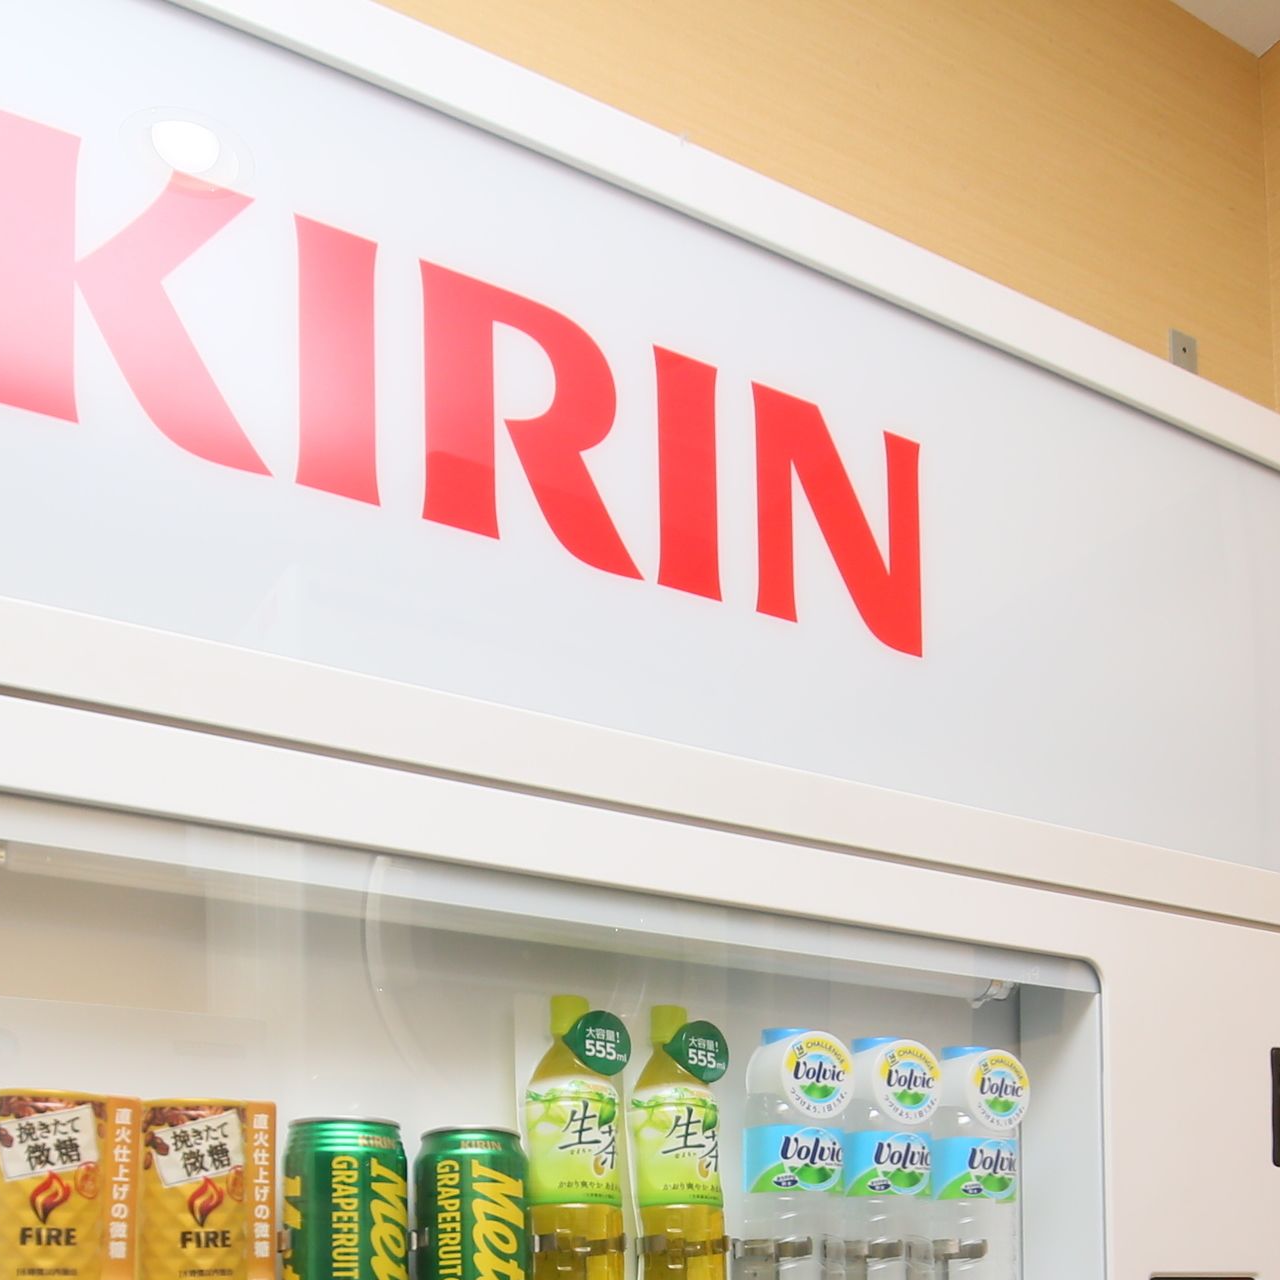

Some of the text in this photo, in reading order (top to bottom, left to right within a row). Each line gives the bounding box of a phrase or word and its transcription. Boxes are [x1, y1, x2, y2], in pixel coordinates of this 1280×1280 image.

[585, 1026, 621, 1043] 大容量!
[688, 1035, 719, 1053] 大容量!
[793, 1060, 846, 1083] Volvic
[886, 1068, 935, 1090] Volvic
[980, 1076, 1024, 1098] Volvic
[16, 1116, 81, 1144] 挽きたて
[170, 1121, 229, 1151] 挽きたて
[25, 1137, 81, 1171] 微糖
[358, 1135, 398, 1150] KIRIN
[460, 1140, 502, 1151] KIRIN
[182, 1142, 231, 1177] 微糖
[109, 1107, 133, 1259] 直火仕上げの微糖
[253, 1113, 270, 1258] 直火仕上げの微糖
[331, 1156, 360, 1280] GRAPEFRUIT
[436, 1159, 462, 1276] GRAPEFRUIT
[20, 1227, 77, 1246] FIRE
[180, 1230, 232, 1249] FIRE
